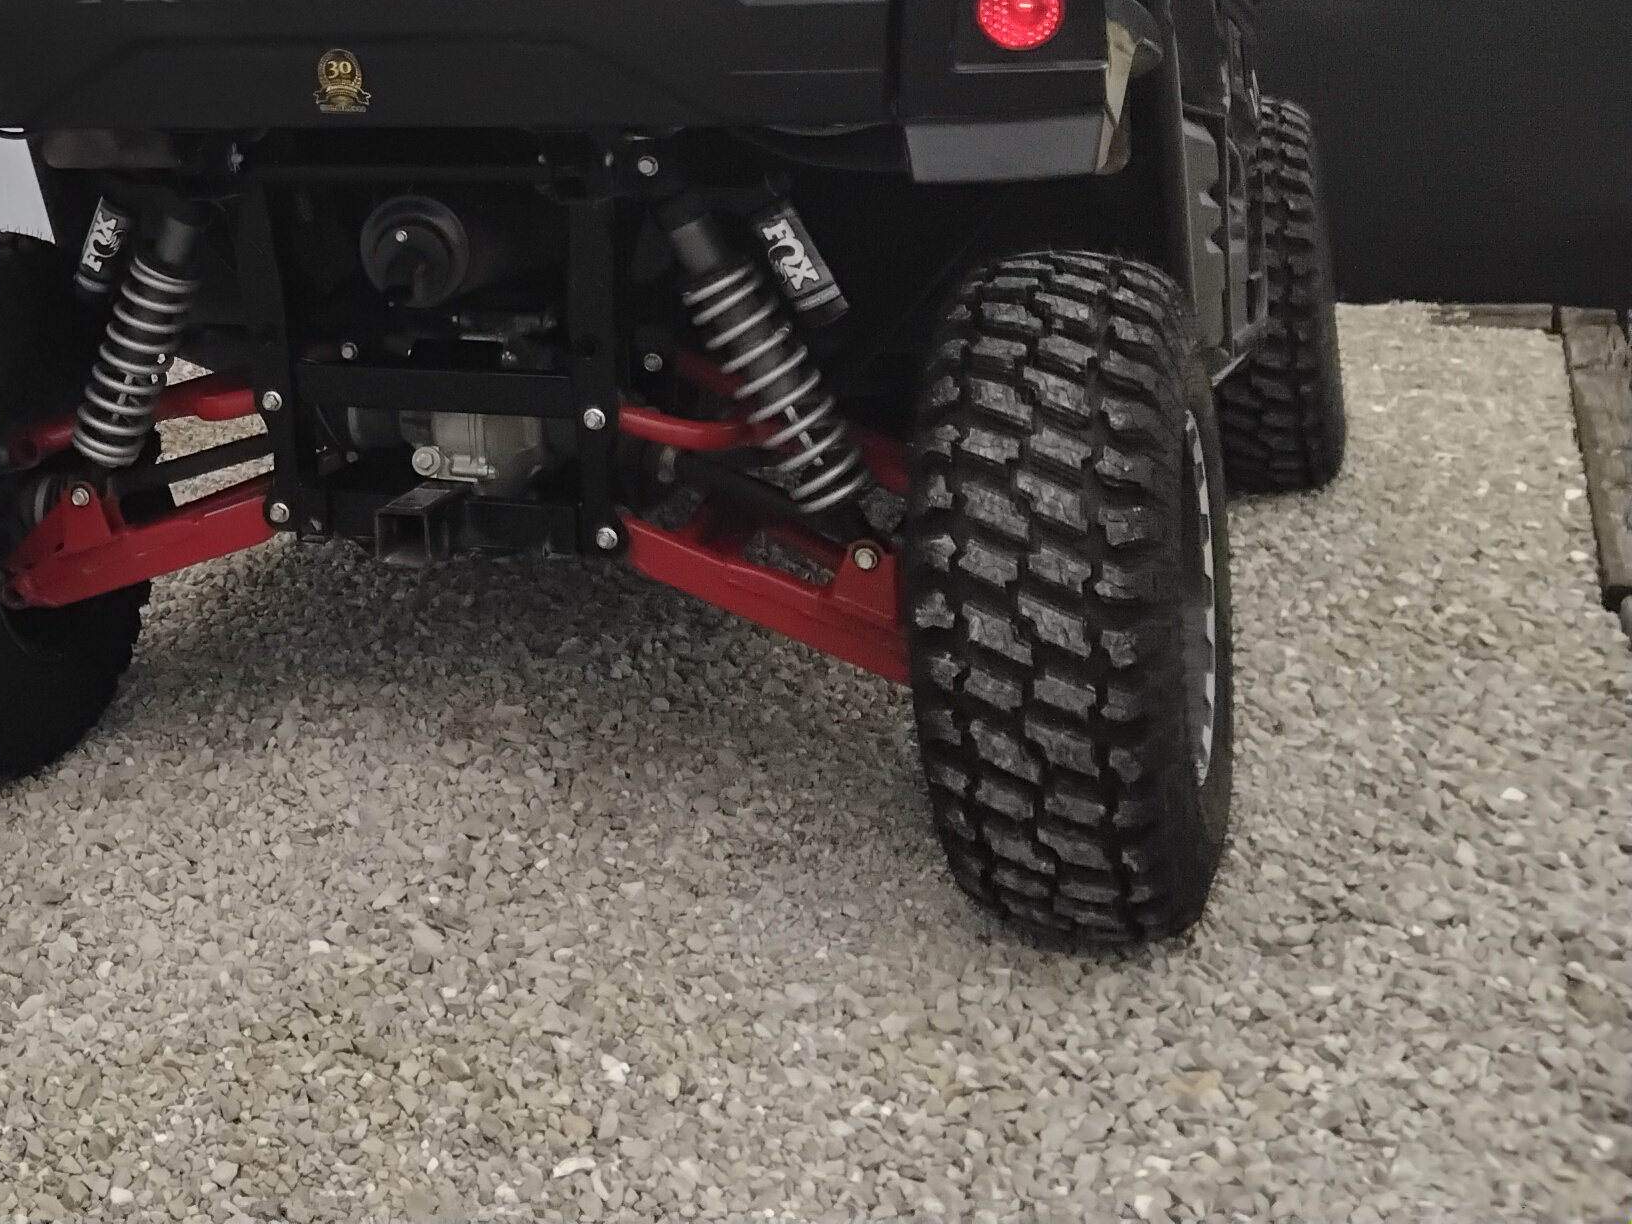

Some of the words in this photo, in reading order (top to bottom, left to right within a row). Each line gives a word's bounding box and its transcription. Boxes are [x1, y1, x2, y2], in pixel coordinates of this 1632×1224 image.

[327, 60, 353, 79] 30
[81, 210, 122, 273] FOX
[762, 218, 820, 291] FOX
